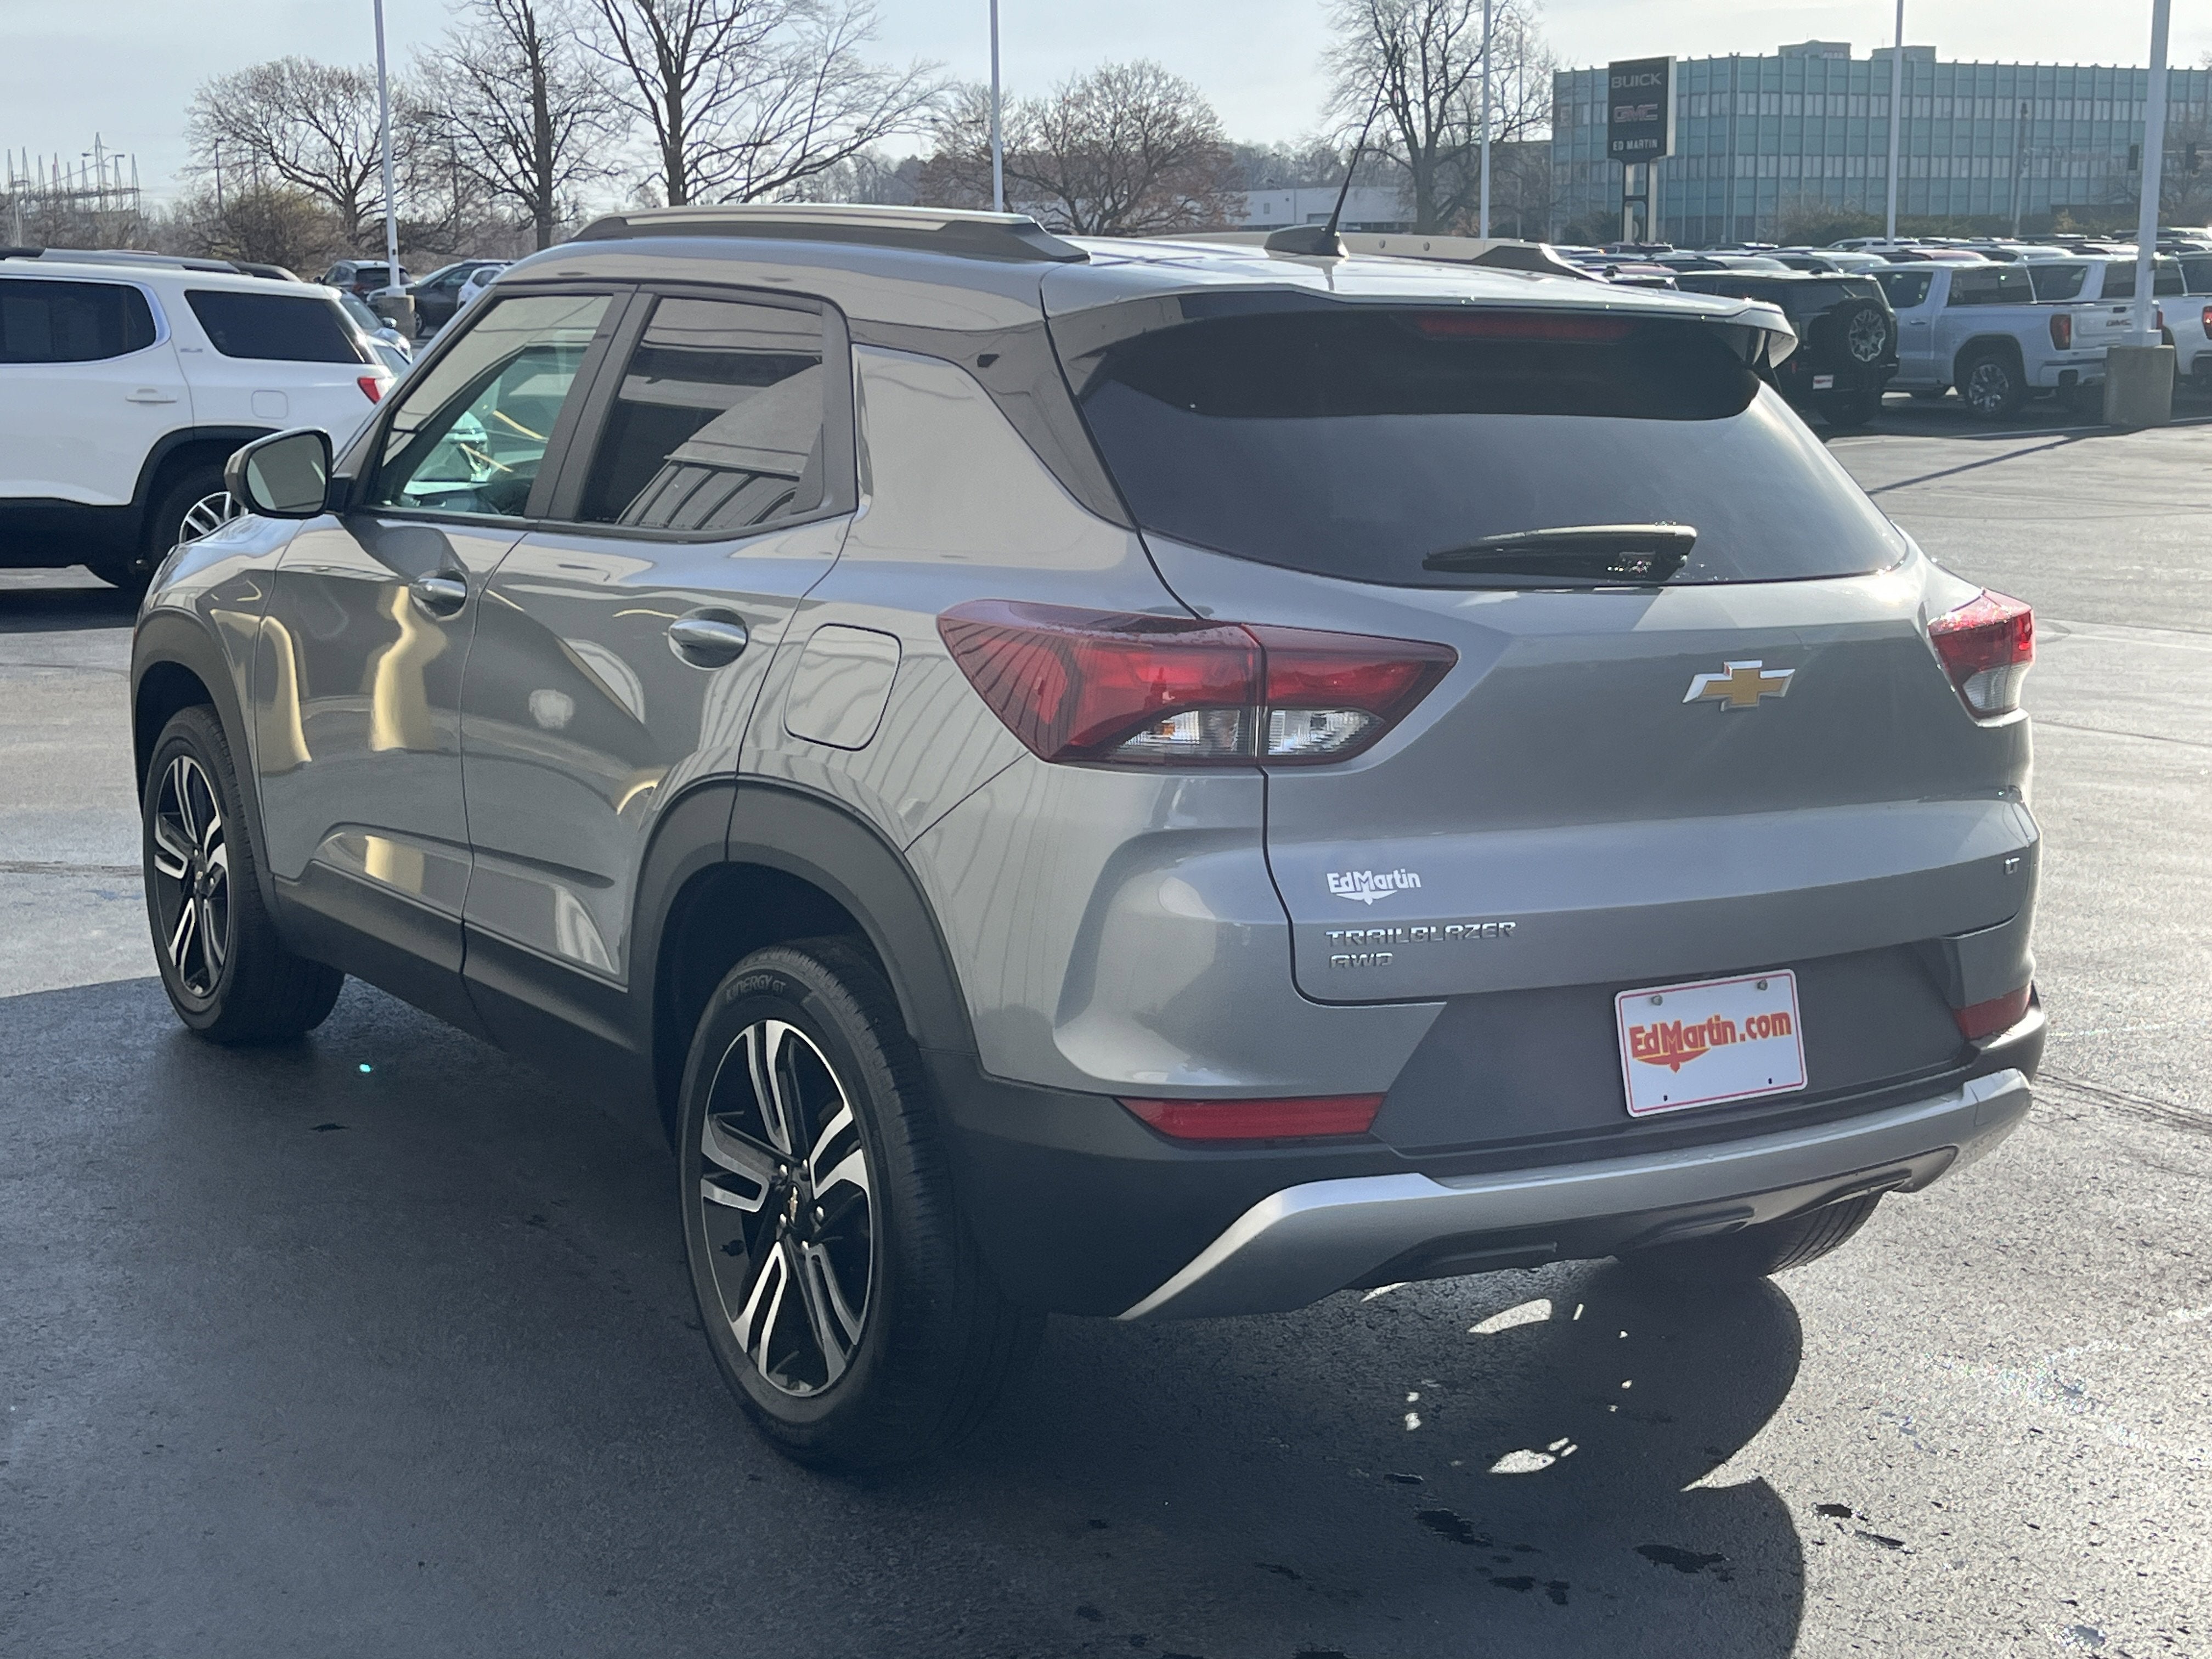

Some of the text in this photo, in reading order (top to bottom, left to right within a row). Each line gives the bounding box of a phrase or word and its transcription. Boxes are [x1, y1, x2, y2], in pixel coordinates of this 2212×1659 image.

[1611, 72, 1662, 89] BUICK
[1613, 103, 1658, 123] GMC
[1612, 138, 1658, 151] ED MARTIN
[1325, 921, 1517, 947] TRAILBLAZER
[1329, 951, 1393, 969] AWD
[772, 980, 786, 992] GT
